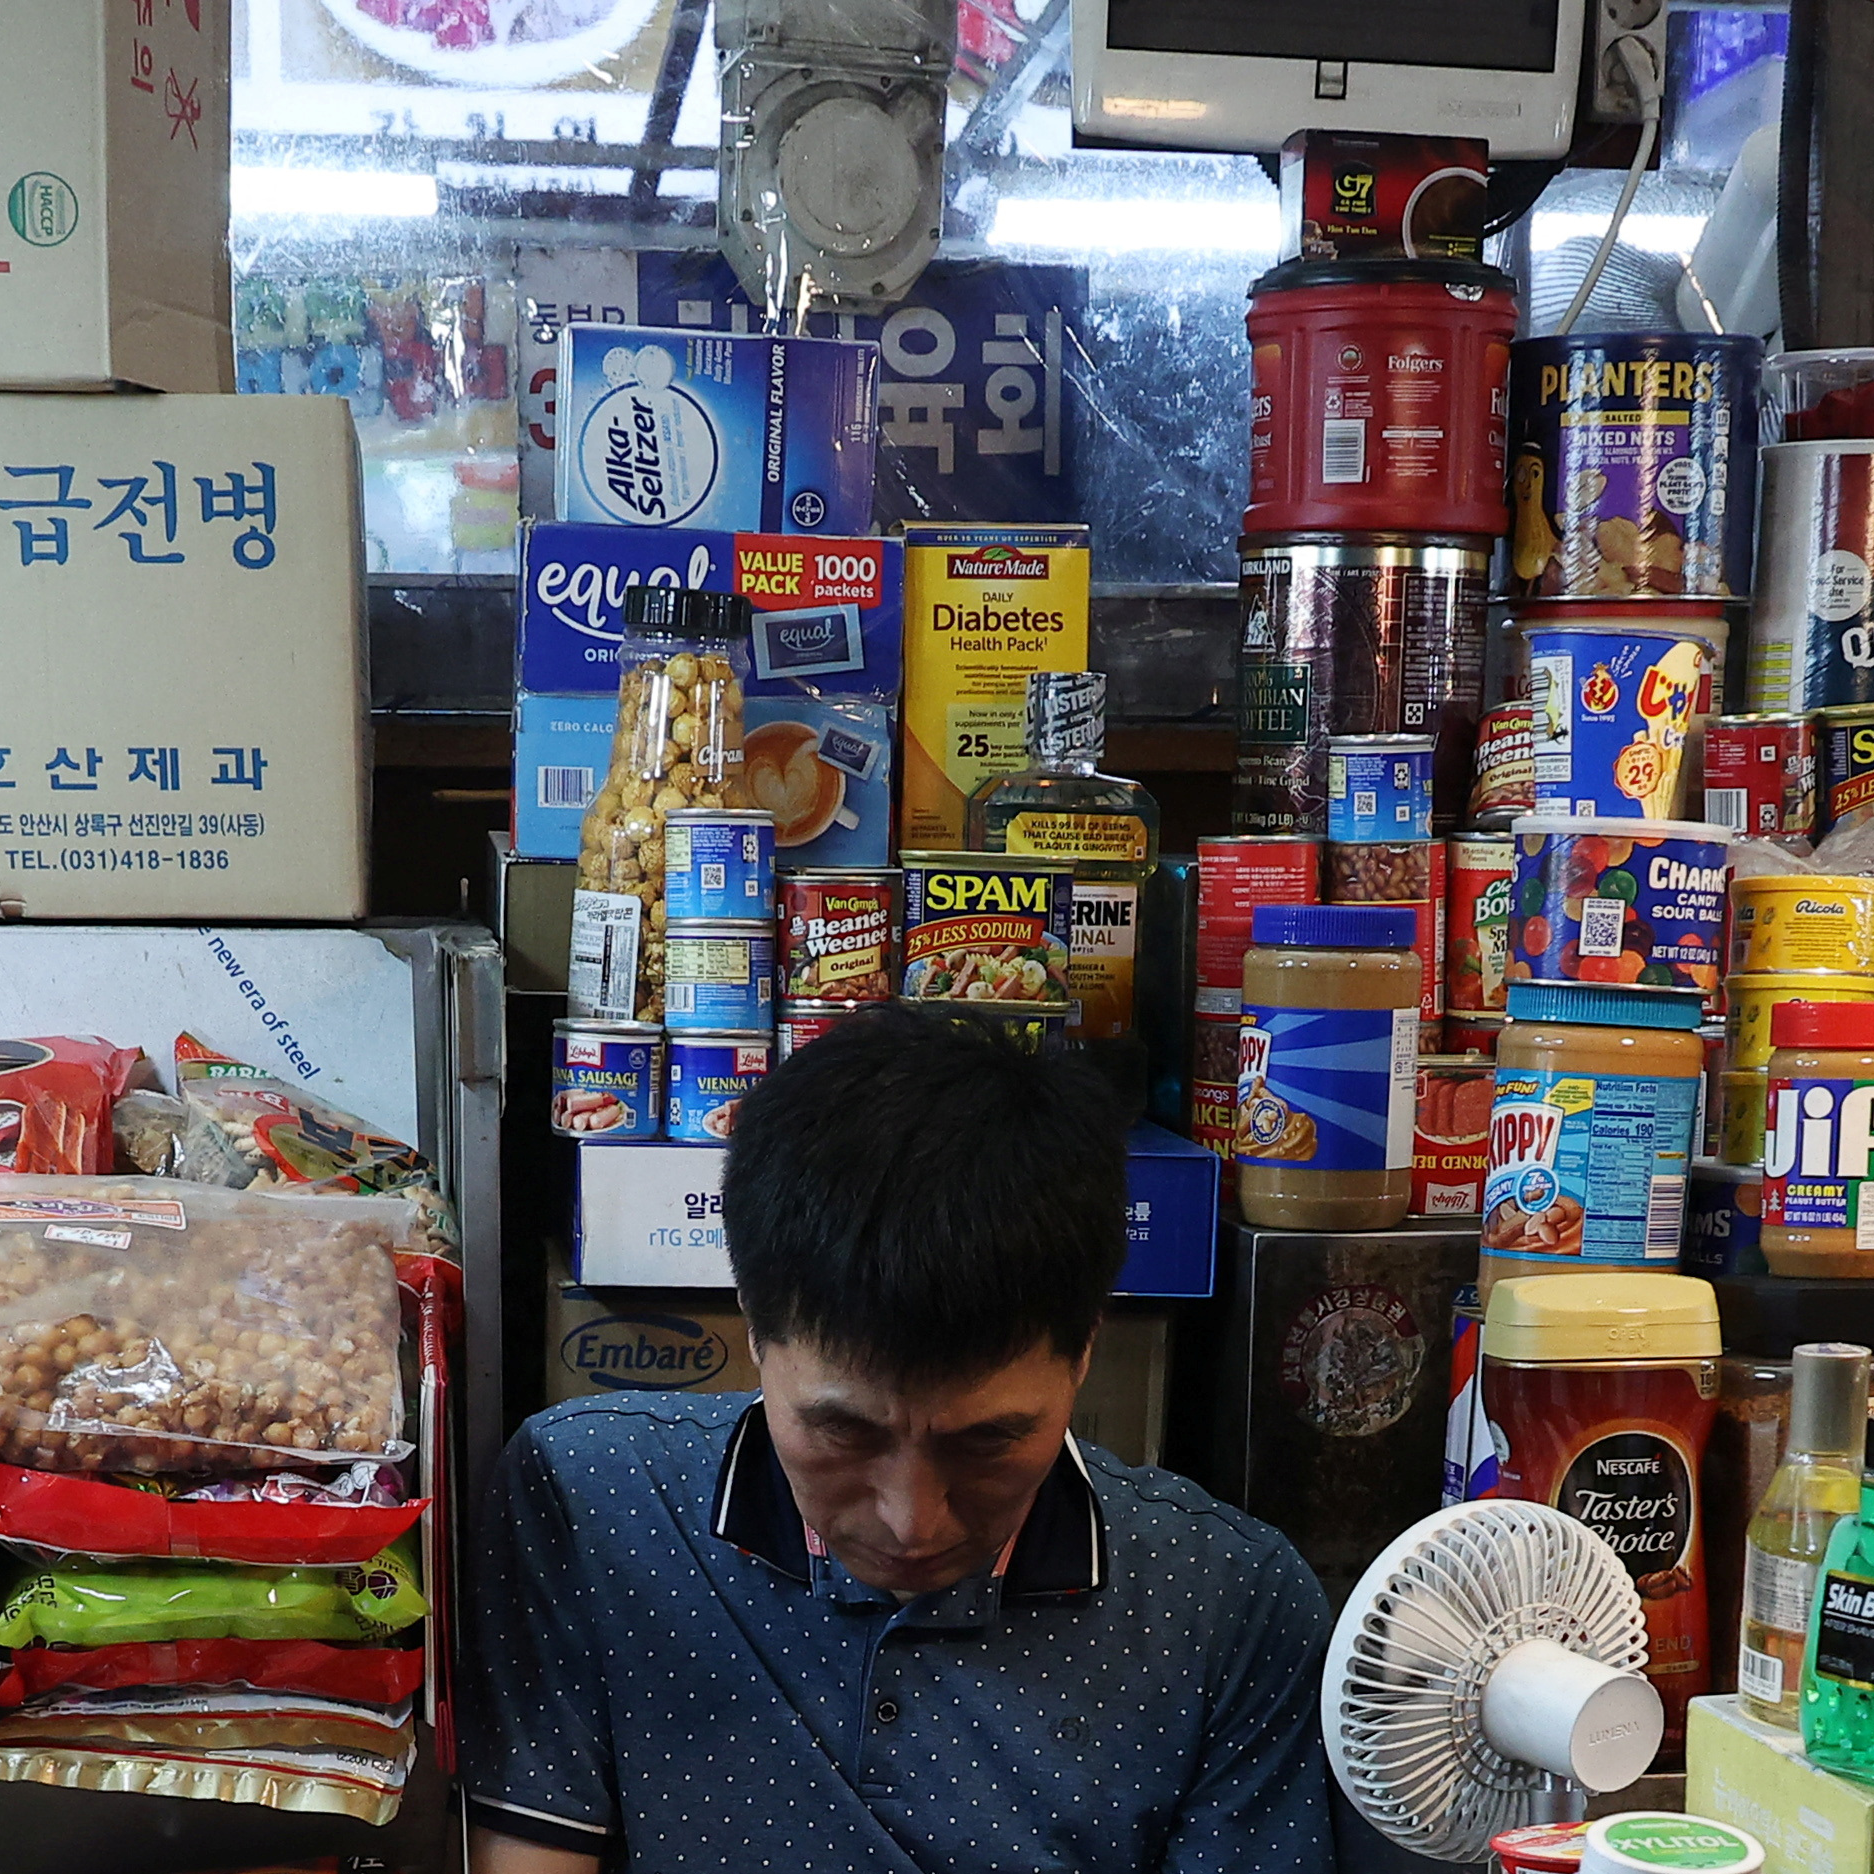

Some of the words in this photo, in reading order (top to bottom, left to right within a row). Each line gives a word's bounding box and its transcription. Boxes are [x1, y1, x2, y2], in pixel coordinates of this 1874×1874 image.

[37, 183, 55, 236] HACCP
[770, 344, 787, 405] FLAVOR
[1387, 353, 1444, 372] Folgers
[1540, 360, 1714, 406] PLANTERS
[766, 406, 783, 484] ORIGINAL
[604, 415, 639, 511] Alka-
[629, 396, 667, 520] Seltzer
[738, 550, 805, 575] VALUE
[813, 554, 877, 583] 1000
[740, 572, 801, 596] PACK
[813, 582, 875, 600] packets
[982, 592, 1014, 603] DAILY
[932, 603, 1065, 633] Diabetes
[949, 636, 1003, 652] Health
[956, 733, 990, 758] 25
[1834, 788, 1859, 811] 25%
[19, 812, 69, 839] 안산시
[73, 812, 124, 840] 상록구
[127, 813, 195, 840] 선진안길
[197, 812, 266, 841] 39(사동)
[1033, 841, 1071, 852] PLAQUE
[4, 847, 230, 873] TEL.(031)418-1836
[926, 874, 1049, 913] SPAM
[1676, 893, 1718, 907] CANDY
[1651, 905, 1697, 921] SOUR
[1795, 900, 1847, 916] Ricola
[807, 908, 888, 940] Beanee
[806, 927, 888, 958] Weenee
[906, 930, 932, 957] 25%
[931, 924, 967, 948] LESS
[969, 920, 1033, 942] SODIUM
[829, 954, 875, 973] Original
[576, 1068, 639, 1087] SAUSAGE
[697, 1076, 748, 1091] VIENNA
[1786, 1183, 1846, 1198] CREAMY
[648, 1228, 683, 1247] rTG
[576, 1334, 716, 1372] Embaré
[1574, 1488, 1679, 1522] Taster's
[1620, 1833, 1740, 1851] XYLITOL
